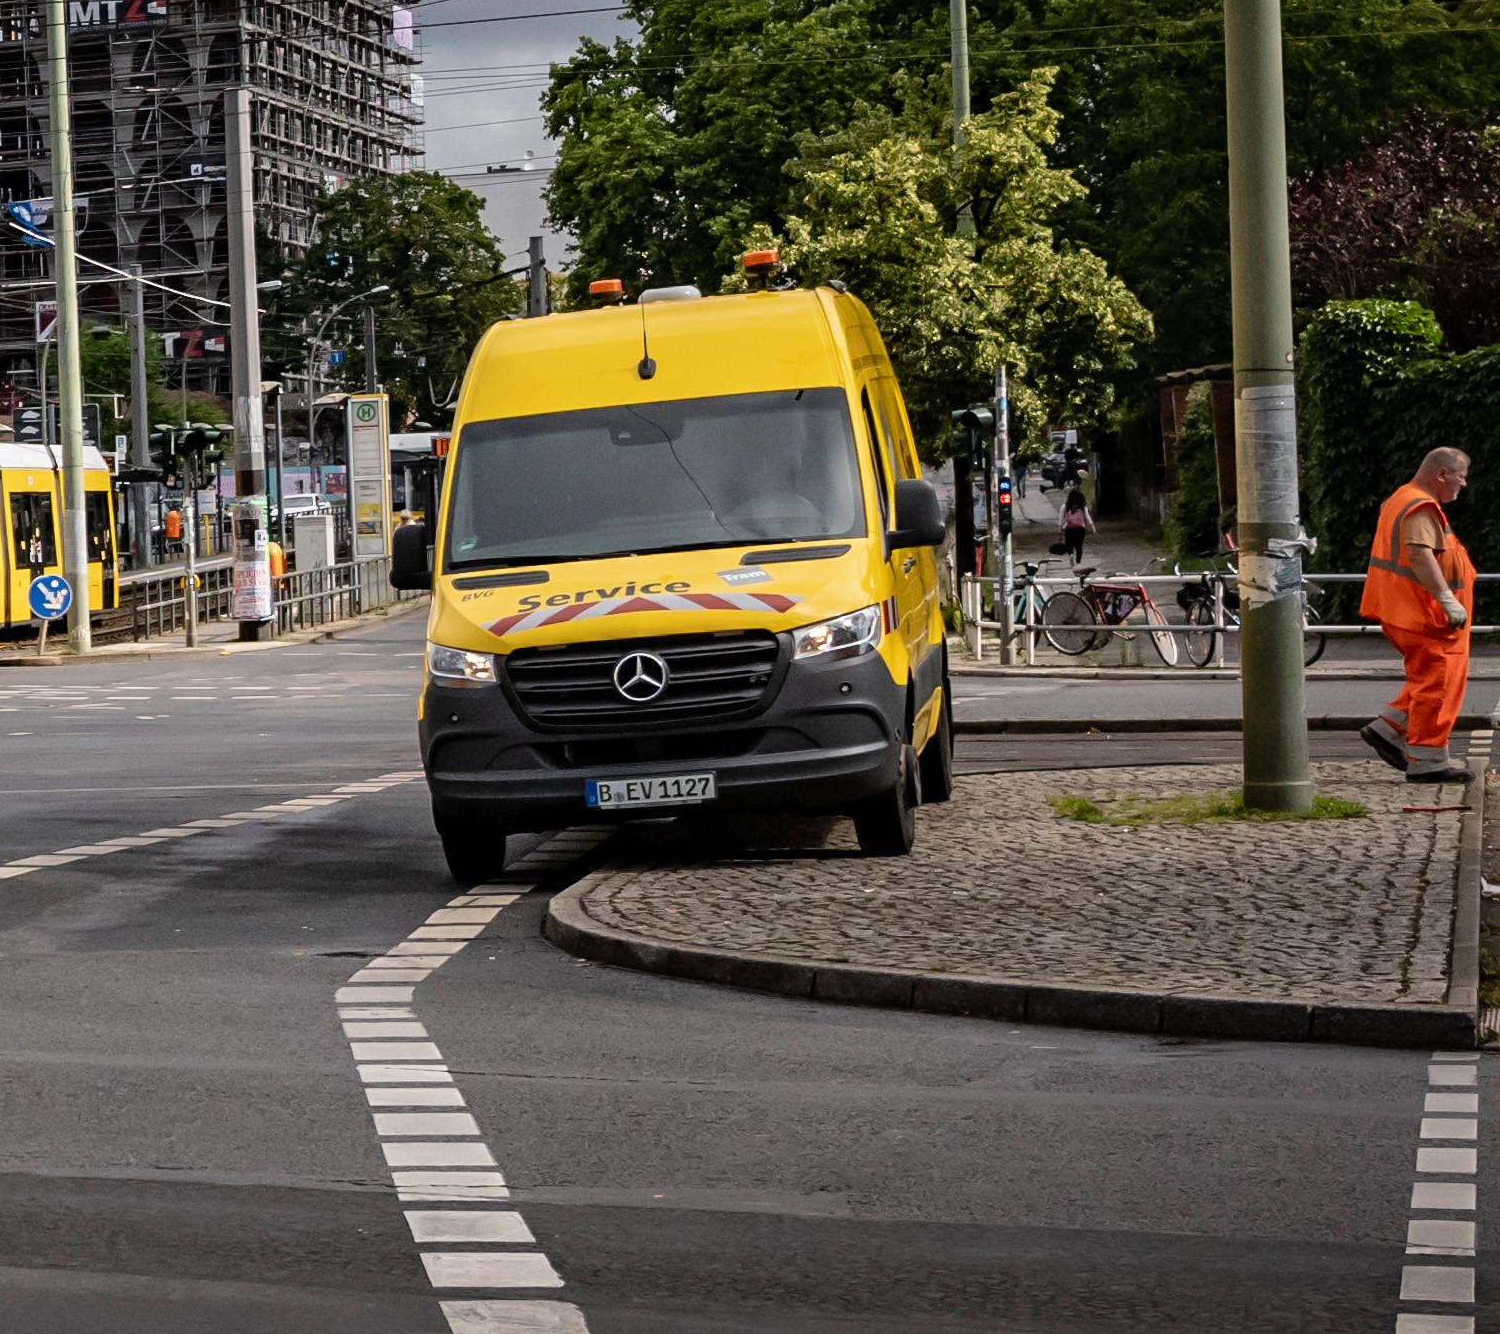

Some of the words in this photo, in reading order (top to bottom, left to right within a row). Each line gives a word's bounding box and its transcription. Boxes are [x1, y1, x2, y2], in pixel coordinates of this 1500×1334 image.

[160, 330, 204, 358] TZ
[721, 569, 766, 583] Tram
[462, 589, 493, 603] BVG
[518, 581, 691, 613] Service
[599, 784, 612, 802] B
[626, 782, 652, 800] EV
[658, 778, 710, 798] 1127
